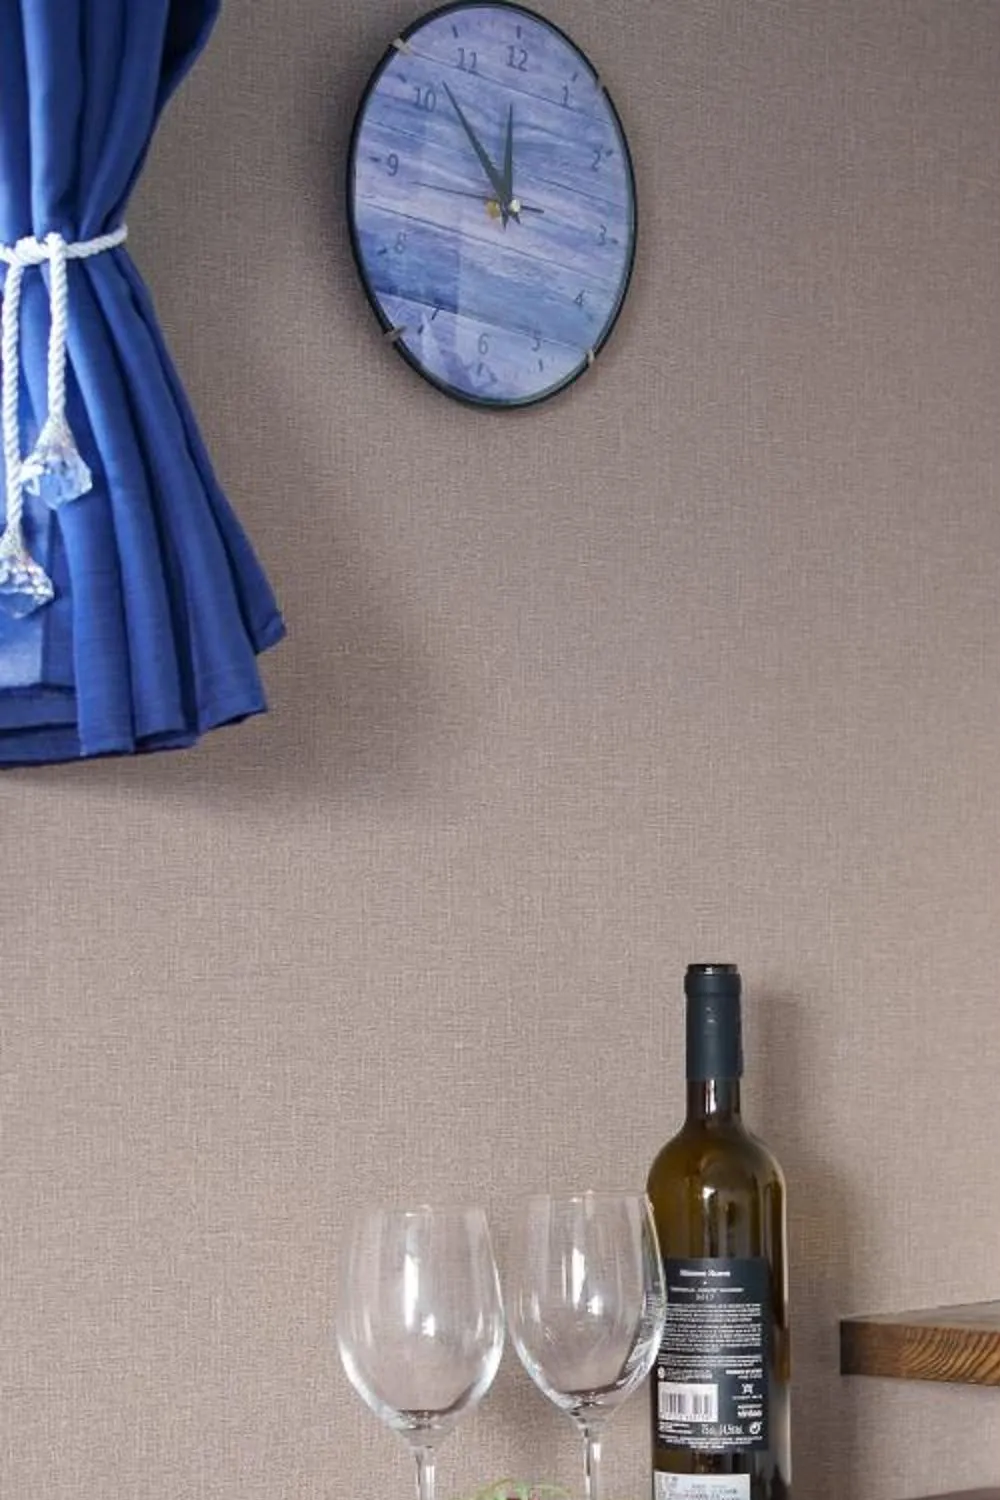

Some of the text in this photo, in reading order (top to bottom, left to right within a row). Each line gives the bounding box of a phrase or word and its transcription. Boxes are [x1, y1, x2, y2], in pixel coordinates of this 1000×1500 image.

[457, 46, 478, 75] 11
[507, 45, 528, 73] 12
[413, 85, 437, 113] 10
[387, 153, 399, 177] 9
[591, 147, 602, 172] 2
[574, 289, 587, 309] 4
[477, 333, 489, 355] 6
